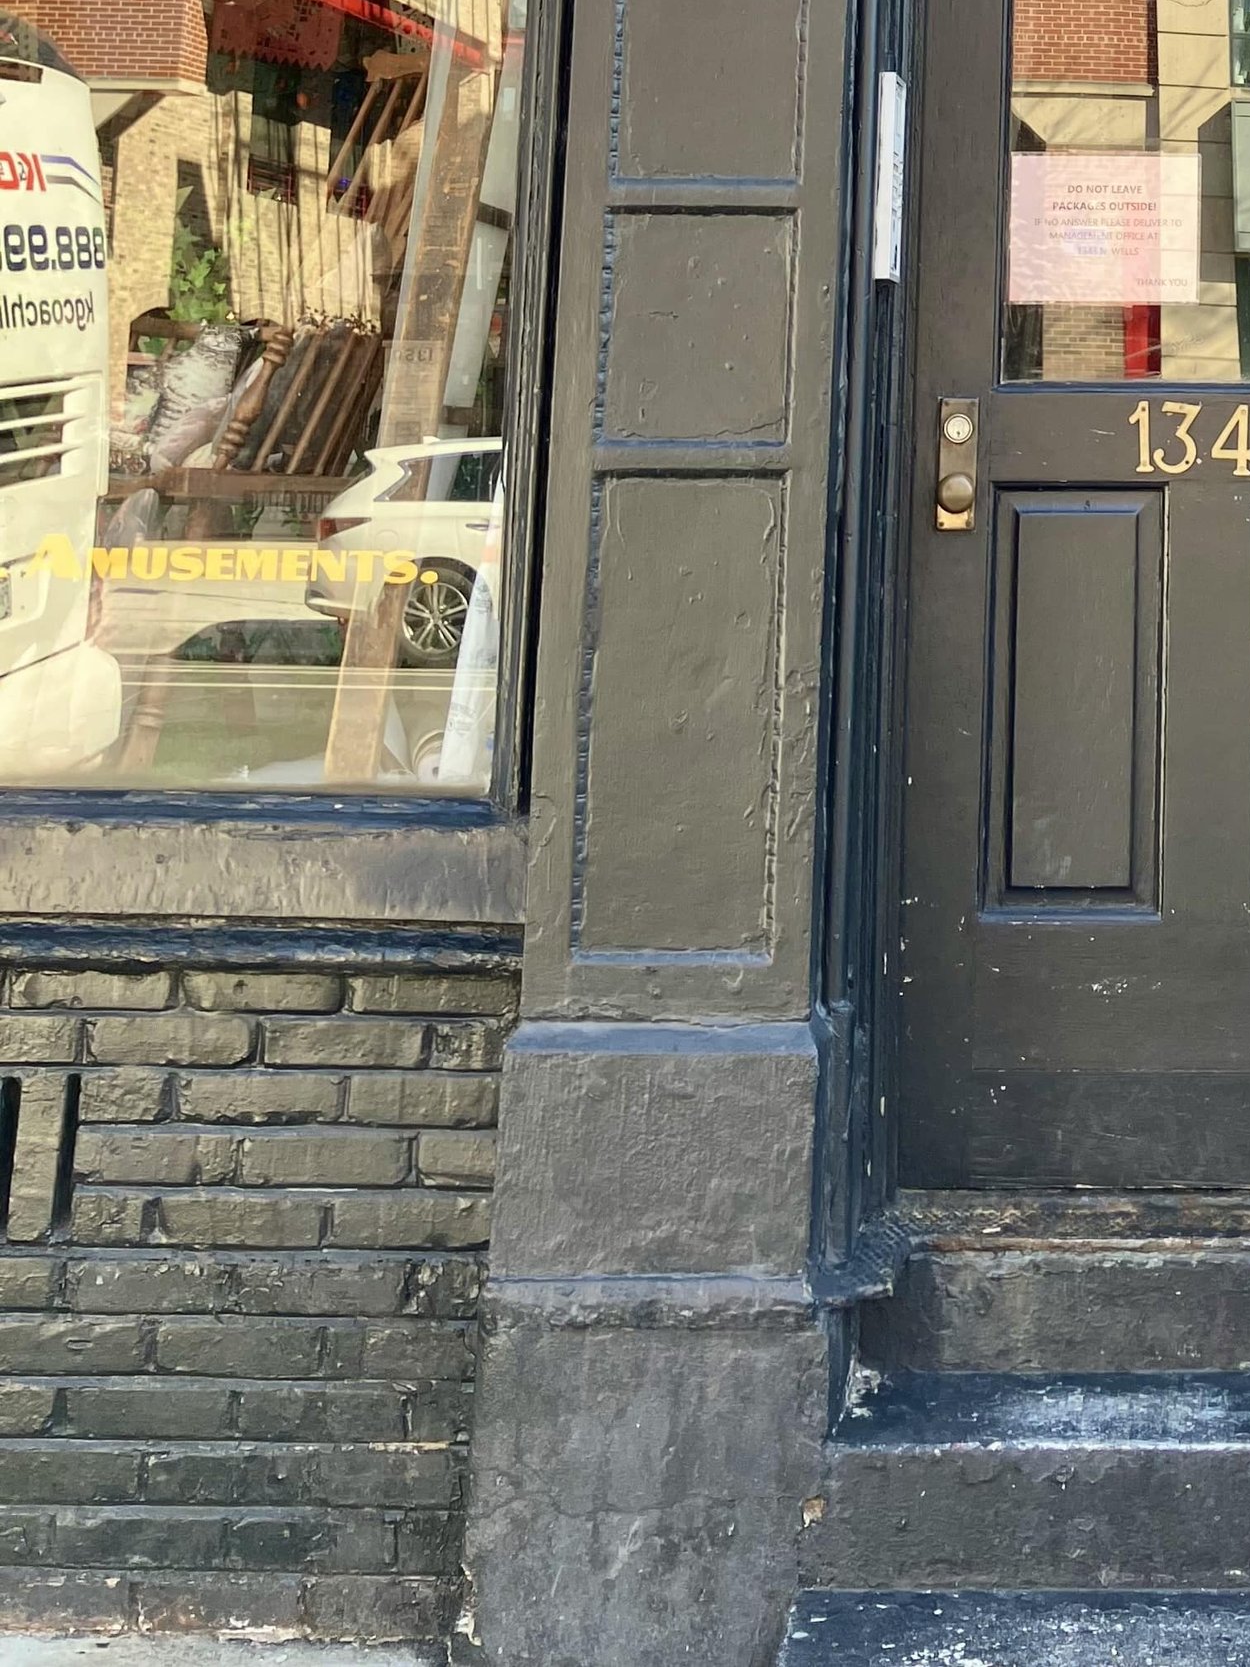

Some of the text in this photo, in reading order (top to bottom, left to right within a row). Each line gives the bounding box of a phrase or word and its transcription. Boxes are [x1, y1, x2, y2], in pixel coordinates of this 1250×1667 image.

[1067, 185, 1143, 194] DO NOT LEAVE
[1052, 201, 1157, 211] PACKAGES OUTSIDE!
[1034, 218, 1042, 226] IF
[1060, 218, 1098, 227] ANSWER
[1100, 218, 1131, 227] PLEASE
[1133, 218, 1168, 227] DELIVER
[1115, 231, 1145, 241] OFFICE
[1111, 247, 1139, 256] WELLS
[1136, 277, 1188, 286] THANK YOU
[24, 533, 439, 585] AMUSEMENTS.
